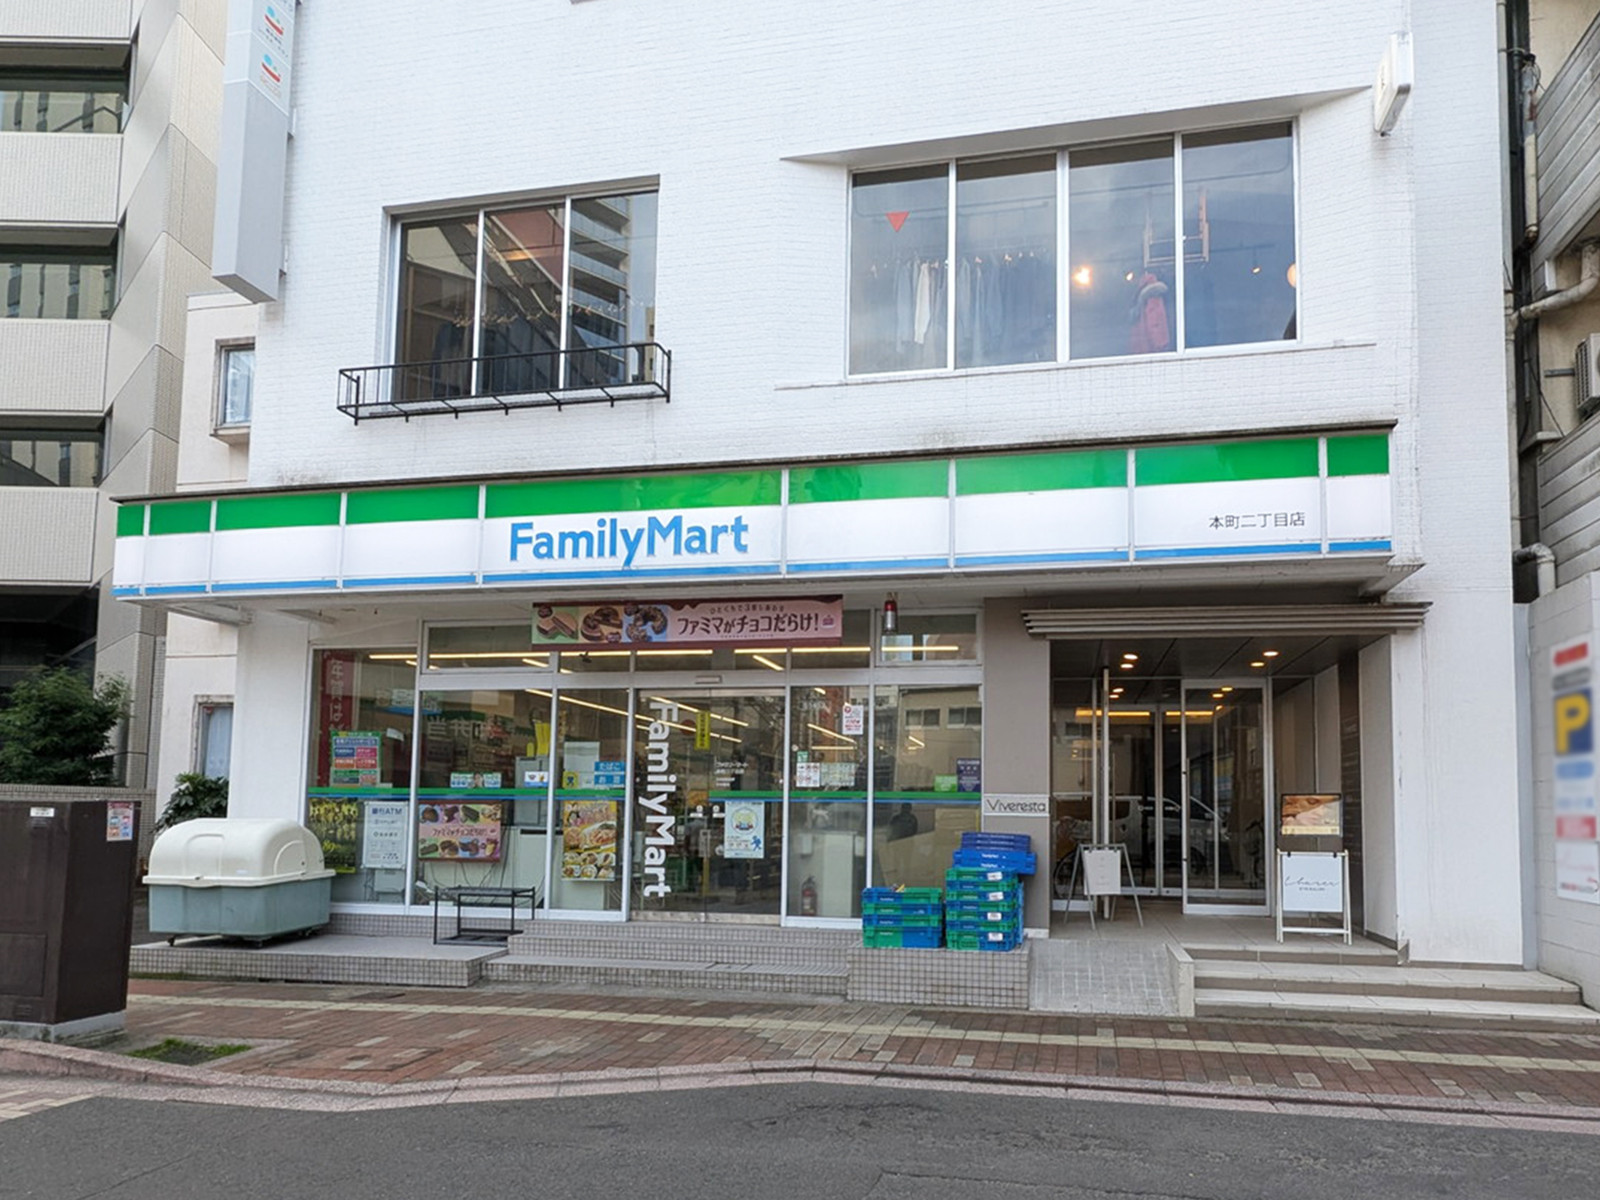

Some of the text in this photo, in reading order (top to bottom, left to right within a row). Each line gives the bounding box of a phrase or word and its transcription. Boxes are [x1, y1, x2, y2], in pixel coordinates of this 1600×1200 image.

[1209, 512, 1305, 530] 本町二丁目店
[510, 515, 748, 570] FamilyMart
[678, 613, 819, 635] ファミマがチョコだらけ!
[1556, 693, 1590, 756] P
[639, 703, 679, 897] FamilyMart
[987, 799, 1046, 812] Viveresta
